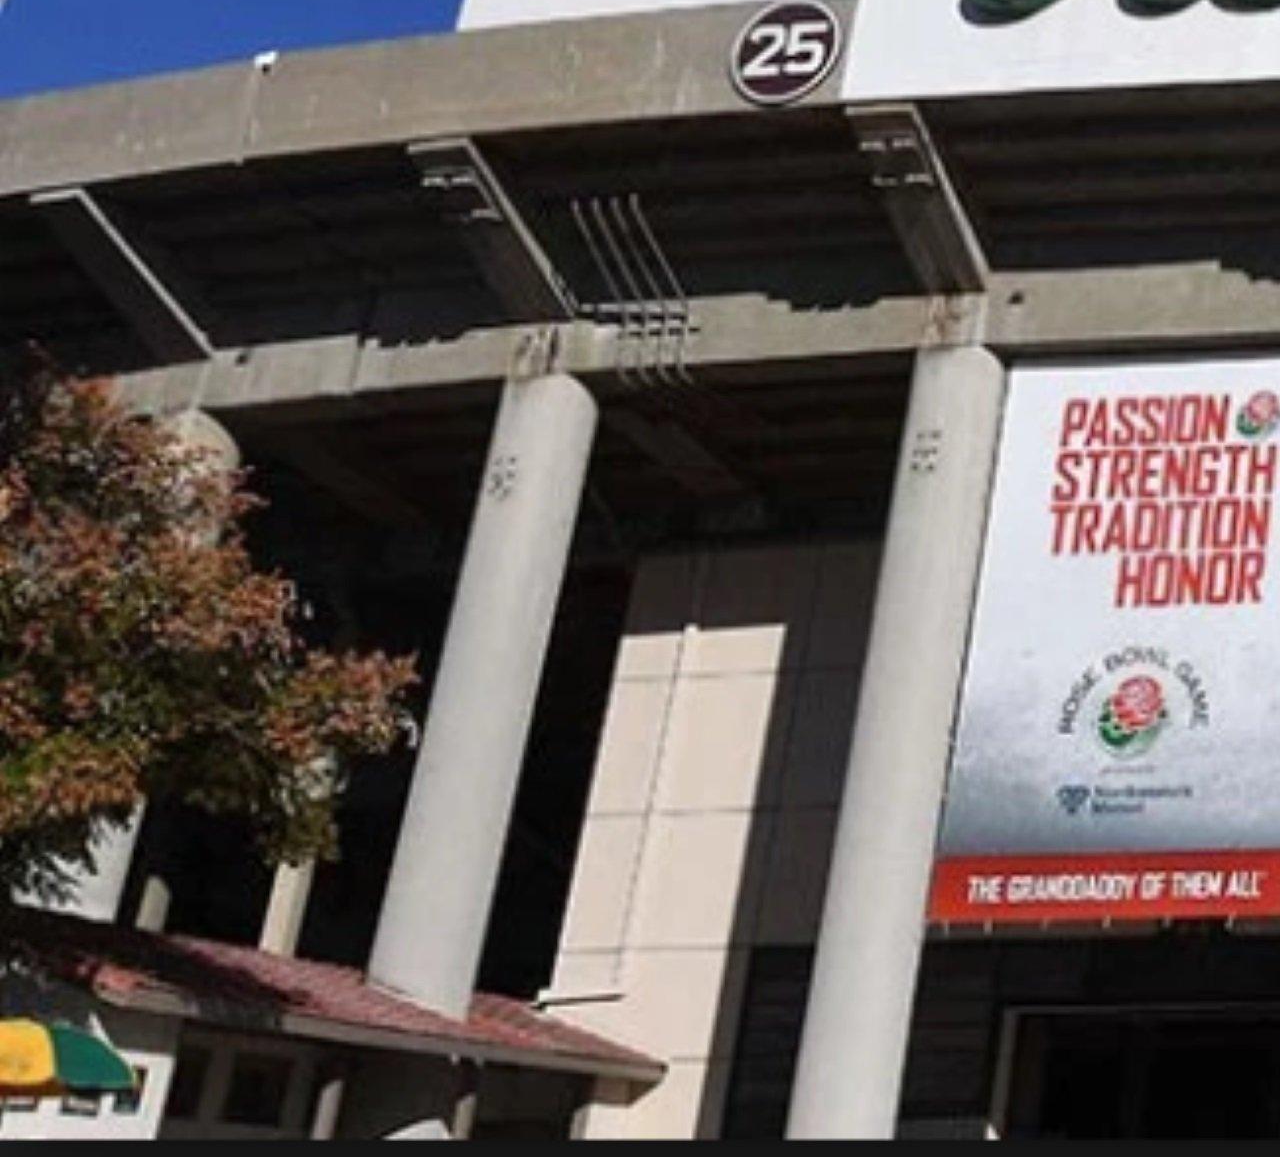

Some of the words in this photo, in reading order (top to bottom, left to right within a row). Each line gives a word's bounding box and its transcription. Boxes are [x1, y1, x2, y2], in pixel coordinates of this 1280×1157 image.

[743, 20, 829, 76] 25
[1060, 393, 1231, 447] PASSION
[1051, 444, 1277, 502] STRENGTH
[1050, 497, 1271, 556] TRADITION
[1115, 551, 1264, 608] HONOR
[967, 875, 1003, 904] THE
[1140, 872, 1166, 900] OF
[1225, 870, 1260, 899] ALL
